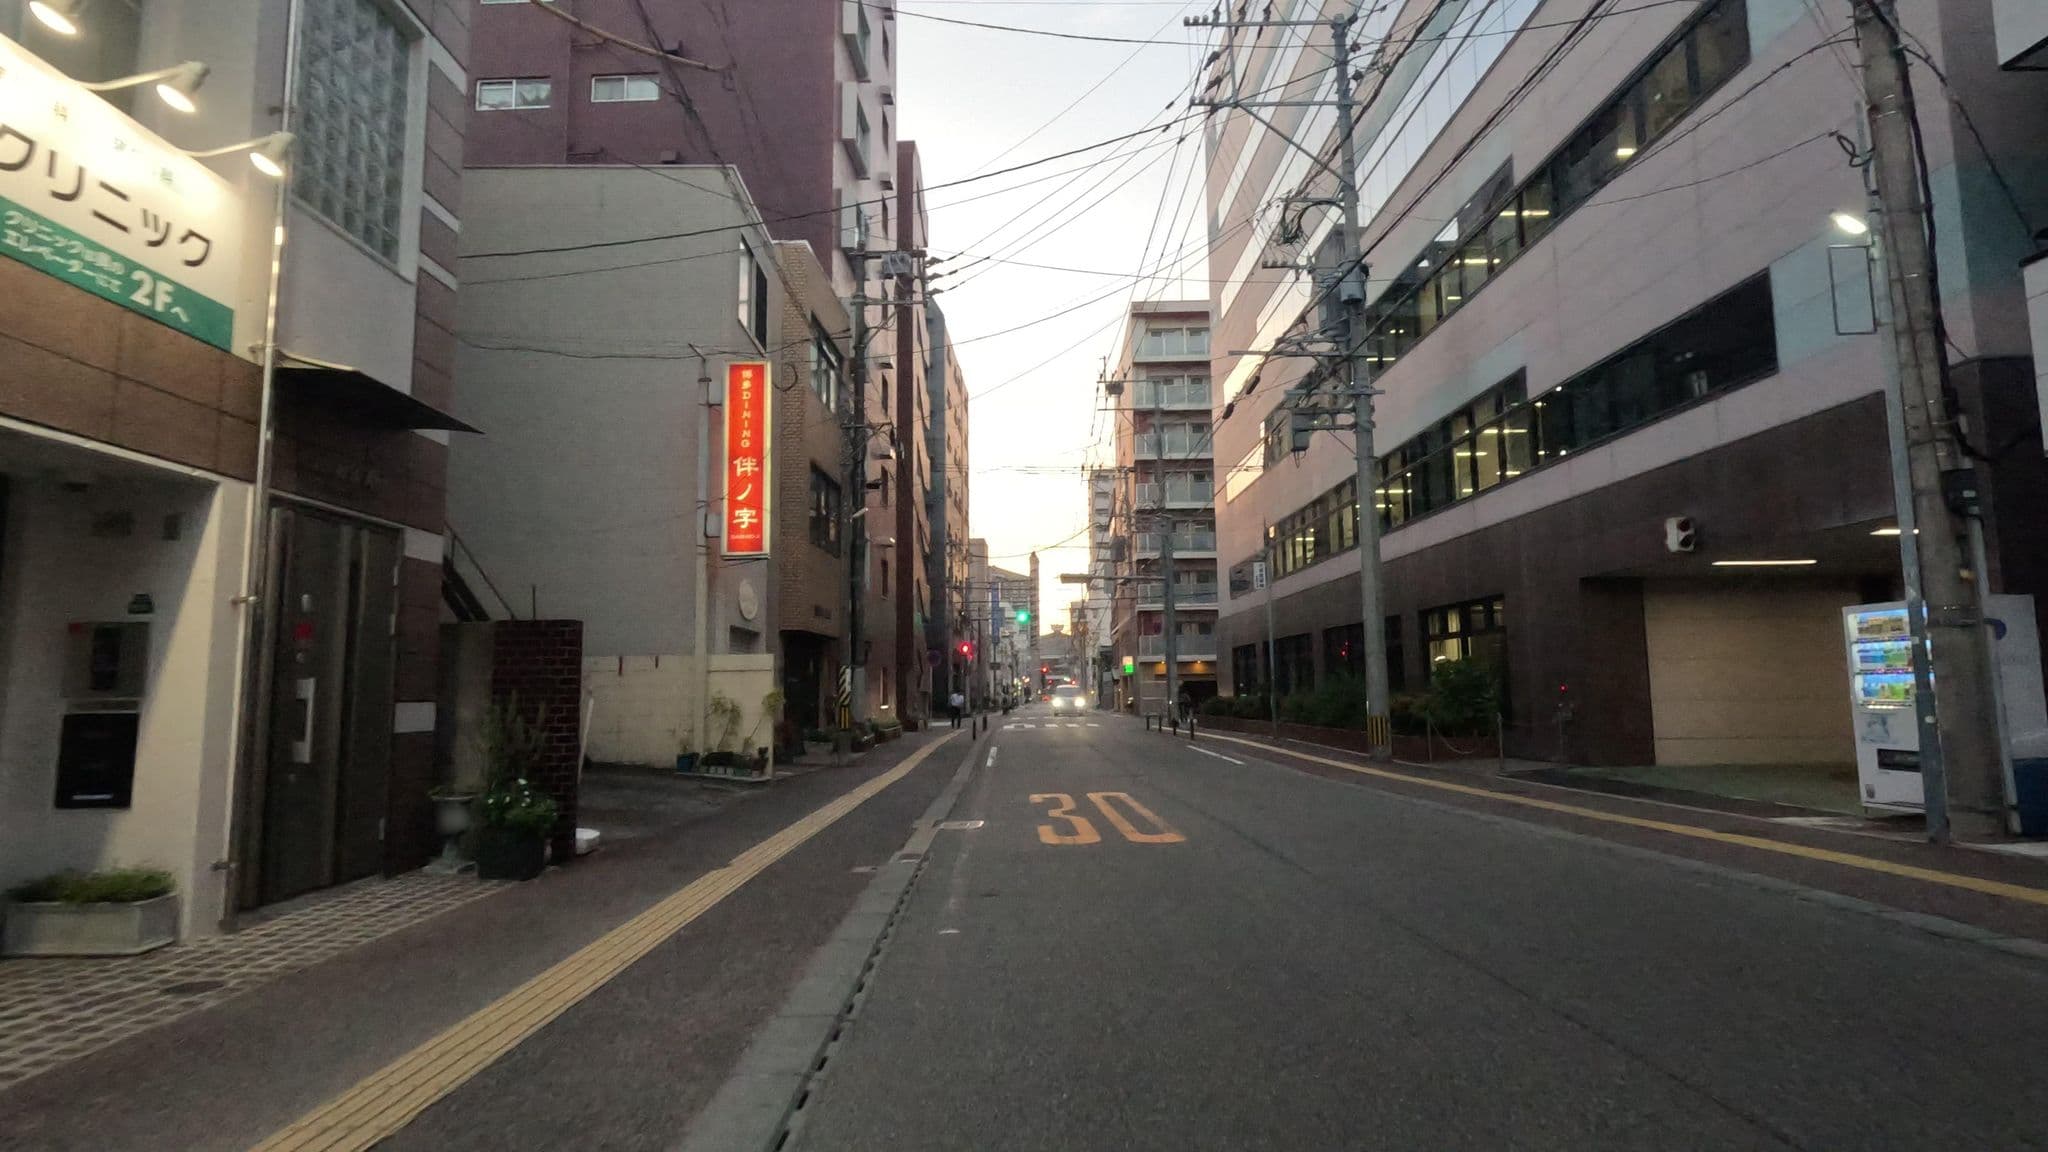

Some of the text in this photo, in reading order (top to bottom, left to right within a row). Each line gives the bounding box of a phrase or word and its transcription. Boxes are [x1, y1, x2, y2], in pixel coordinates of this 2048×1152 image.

[732, 456, 760, 529] 伴ノ字
[1028, 791, 1187, 844] 30
